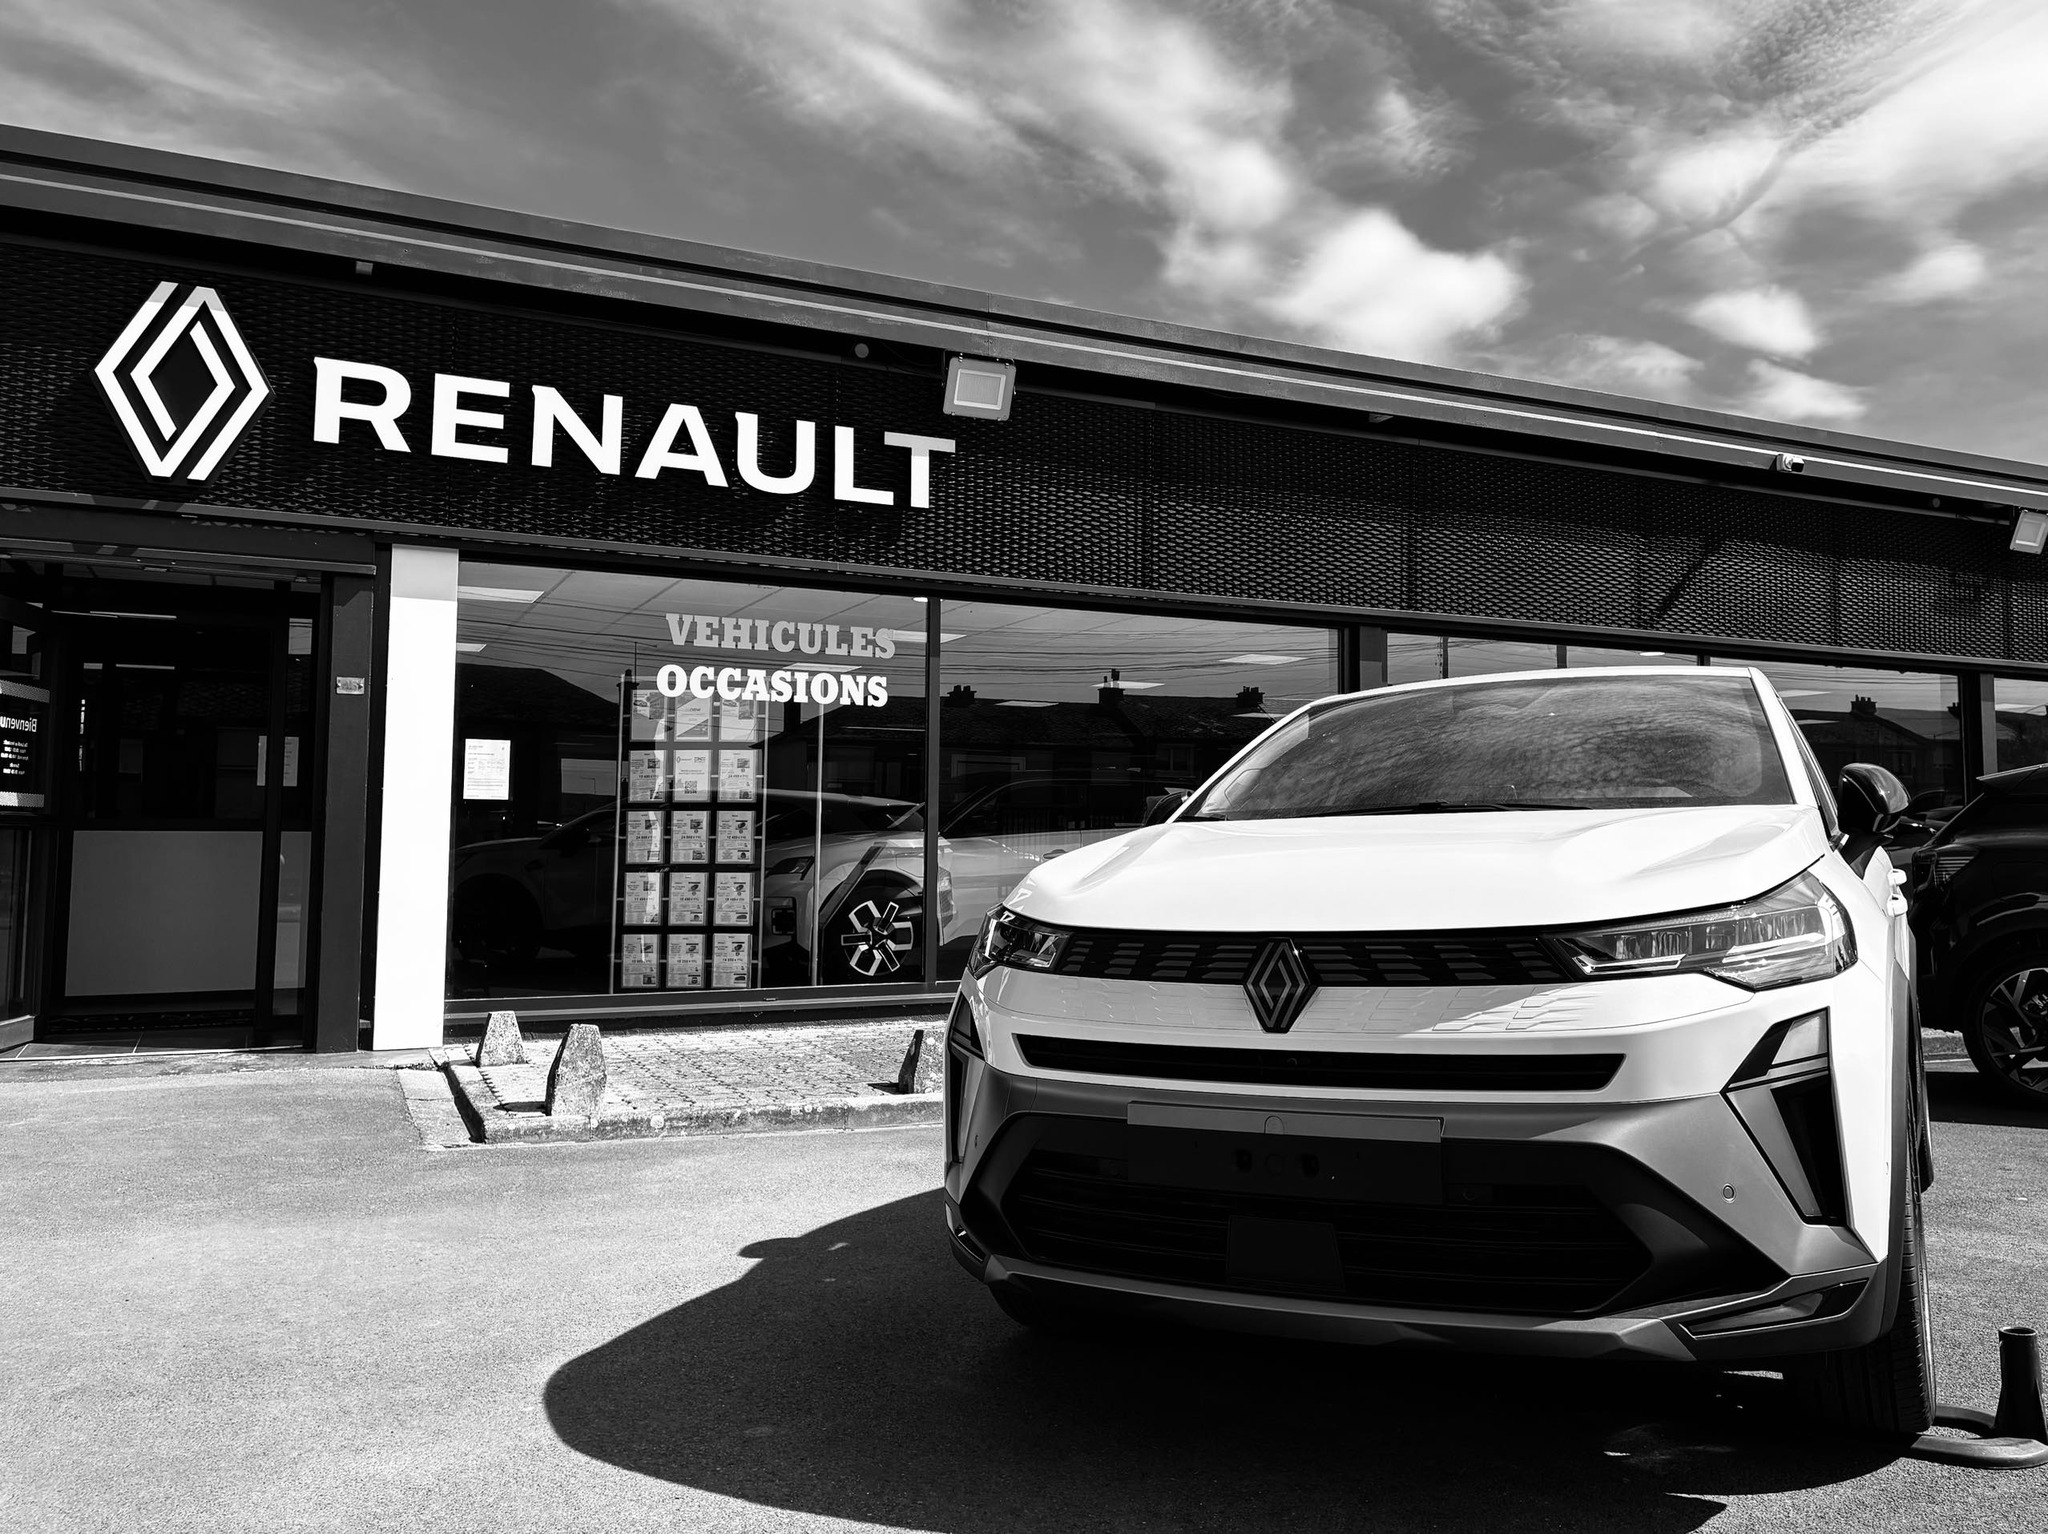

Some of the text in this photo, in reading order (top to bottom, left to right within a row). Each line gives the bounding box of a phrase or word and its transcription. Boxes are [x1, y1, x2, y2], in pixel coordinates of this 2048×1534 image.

[313, 357, 956, 509] RENAULT
[666, 613, 896, 659] VEHICULES
[656, 664, 889, 708] OCCASIONS
